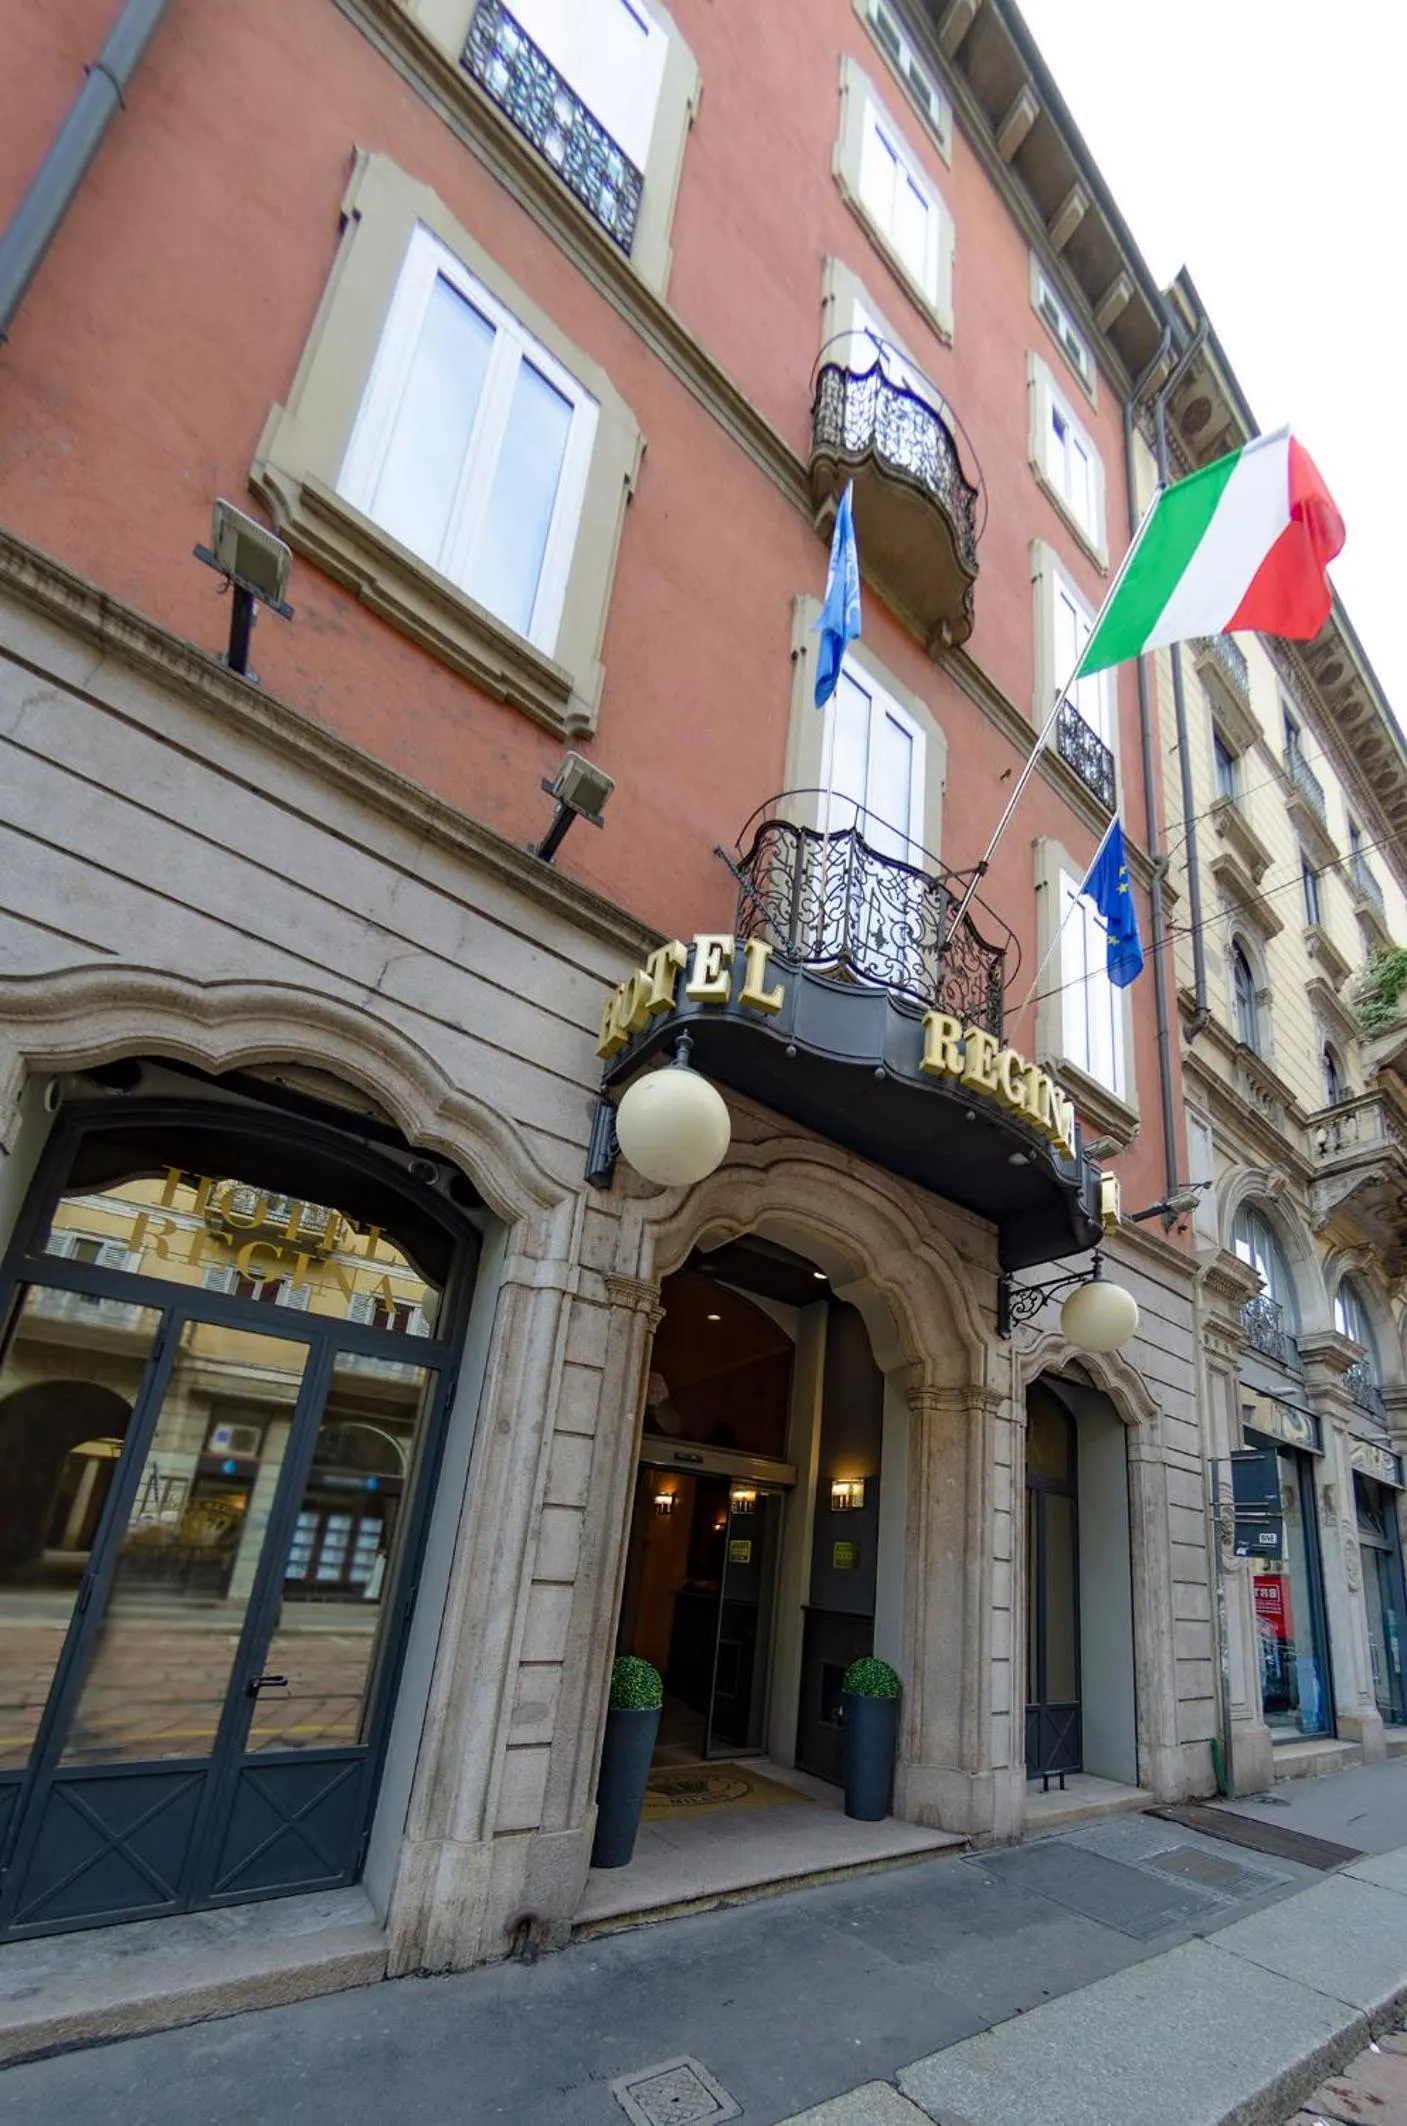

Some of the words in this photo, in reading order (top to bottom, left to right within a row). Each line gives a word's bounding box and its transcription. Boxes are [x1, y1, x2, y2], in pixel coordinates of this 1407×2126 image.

[595, 933, 785, 1059] HOTEL
[126, 1211, 402, 1314] REGINA
[161, 1164, 398, 1266] HOTEL
